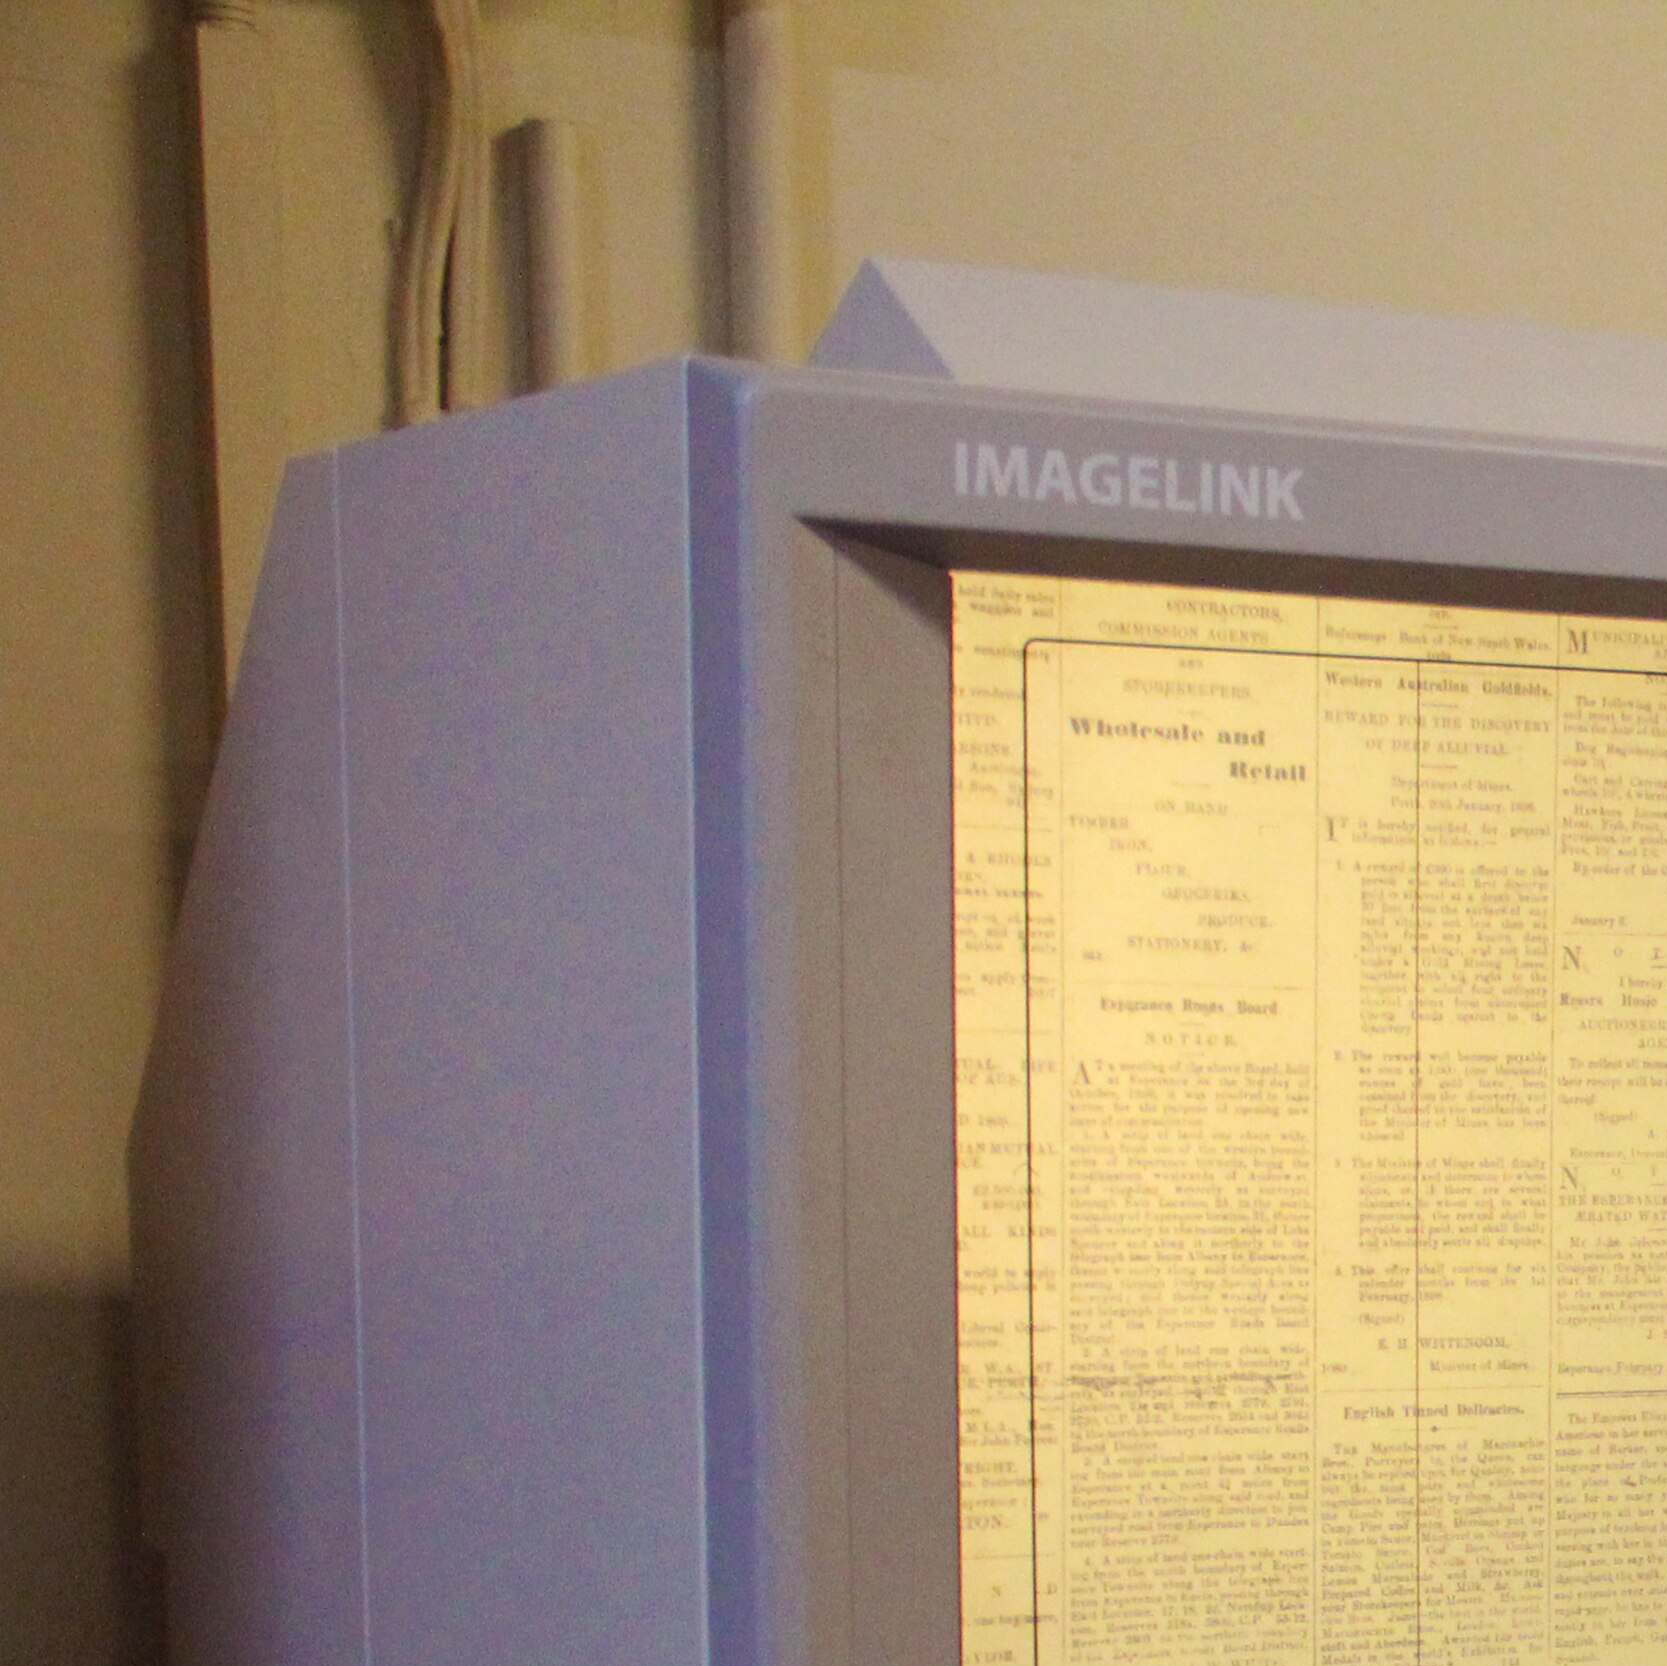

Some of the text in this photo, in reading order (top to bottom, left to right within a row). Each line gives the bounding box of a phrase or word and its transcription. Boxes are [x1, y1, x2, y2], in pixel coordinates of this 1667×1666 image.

[954, 442, 1304, 521] IMAGELINK
[1070, 717, 1265, 747] Wholesale and
[1229, 761, 1307, 782] Retail
[1344, 1405, 1395, 1420] English
